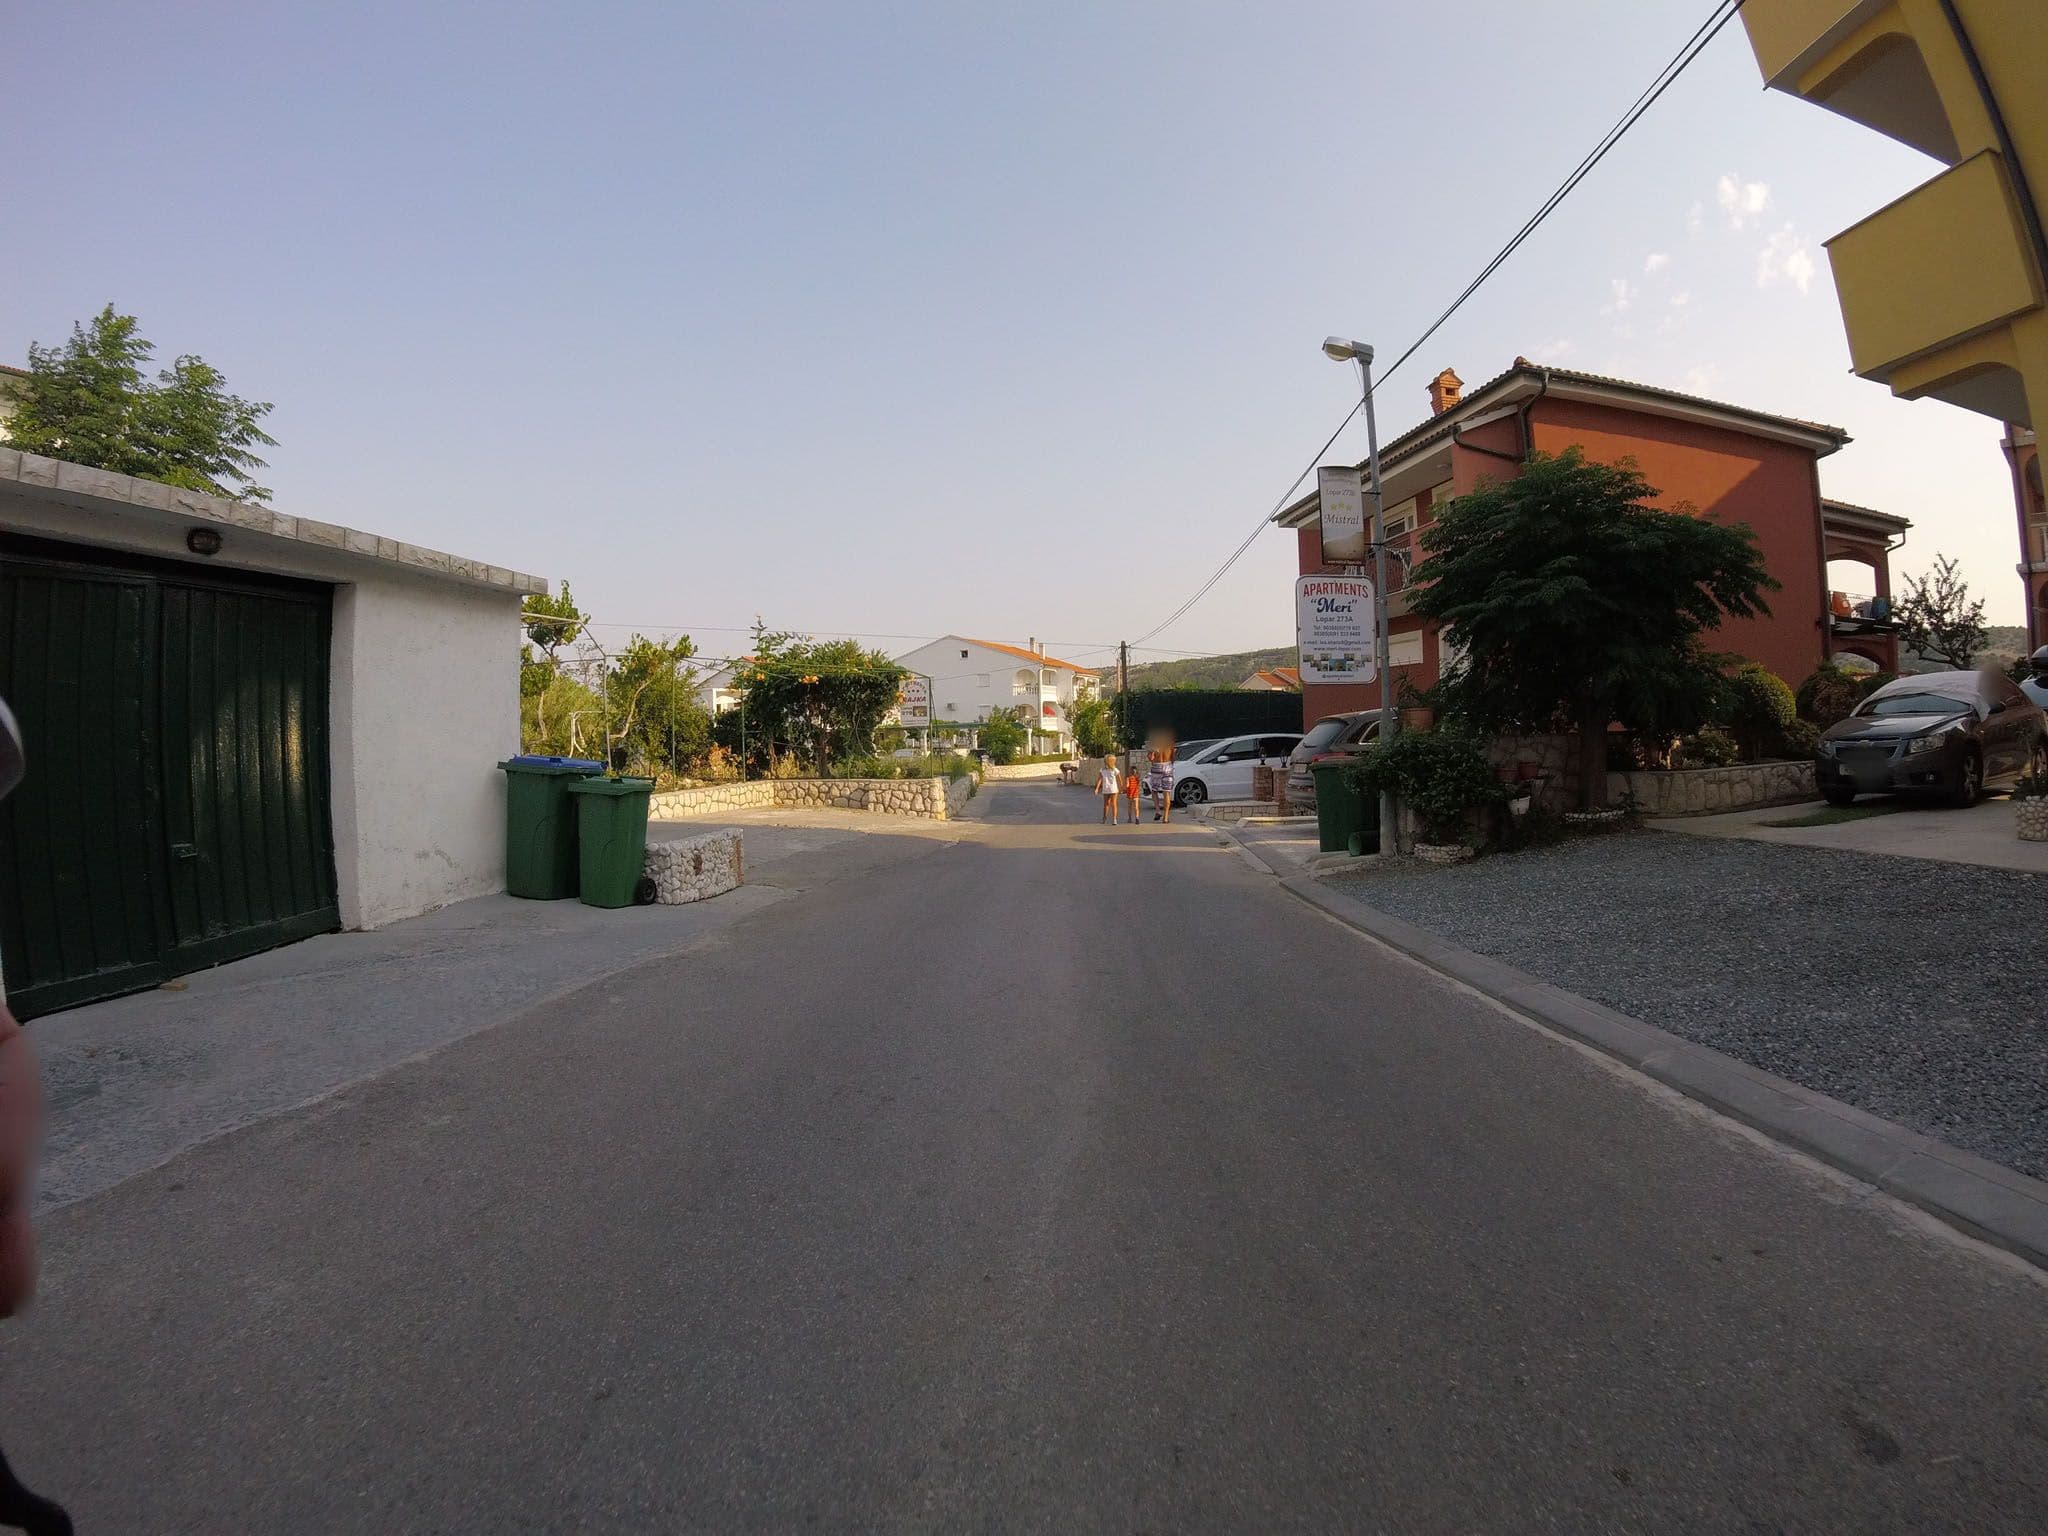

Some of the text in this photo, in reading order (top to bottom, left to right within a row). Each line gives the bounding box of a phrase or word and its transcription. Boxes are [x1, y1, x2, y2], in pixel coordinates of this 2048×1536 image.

[1324, 513, 1360, 525] Mistral
[1303, 582, 1369, 599] APARTMENTS
[1315, 615, 1353, 624] Lopar 273A
